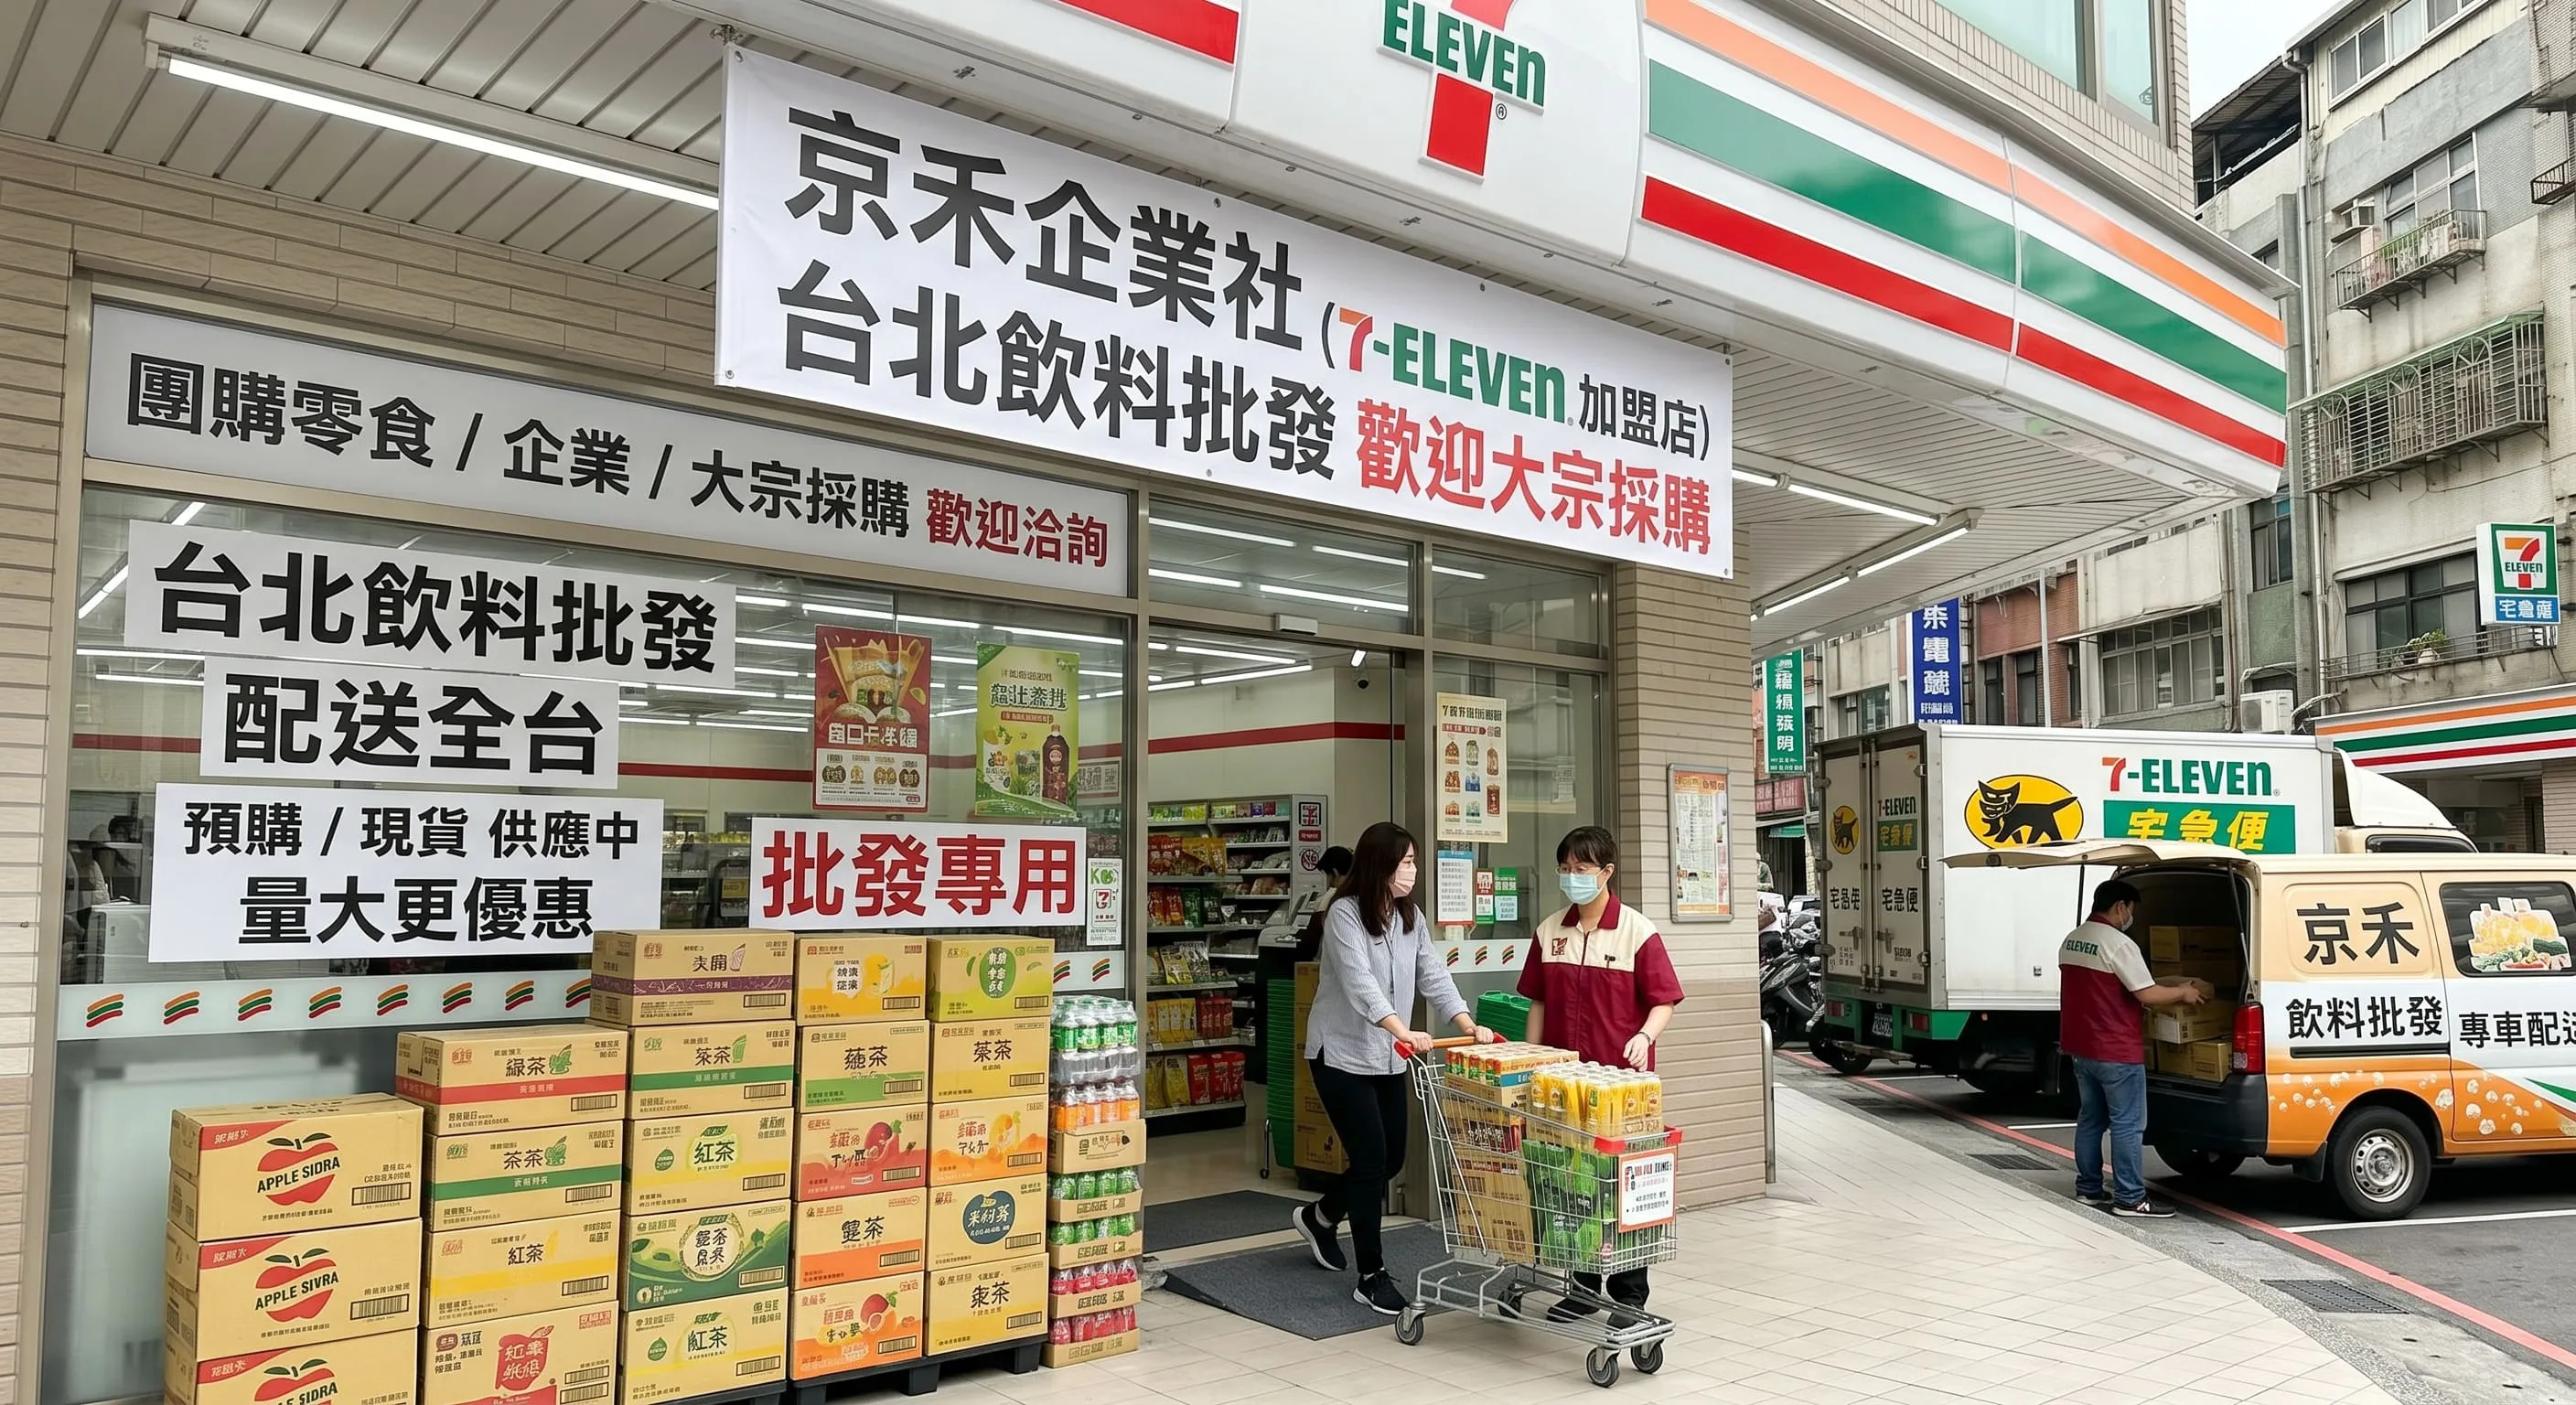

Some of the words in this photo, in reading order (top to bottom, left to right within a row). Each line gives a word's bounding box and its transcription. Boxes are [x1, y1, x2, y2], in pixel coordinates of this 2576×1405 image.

[784, 107, 1304, 351] 京禾企業社
[778, 260, 1336, 481] 台北飲料批發
[1357, 399, 1711, 554] 歡迎大宗採購
[126, 353, 435, 468] 團購零食
[503, 418, 631, 496] 企業
[691, 447, 911, 540] 大宗採購
[927, 489, 1108, 567] 歡迎洽詢
[154, 540, 718, 676] 台北飲料批發
[224, 679, 604, 776] 配送全台
[184, 802, 303, 857] 預購
[360, 806, 469, 859] 現貨
[488, 808, 639, 861] 供應中
[762, 831, 1077, 917] 批發專用
[1882, 887, 1918, 912] 宅急便
[238, 875, 595, 946] 量大更優惠
[2296, 902, 2420, 966] 京禾
[2286, 996, 2443, 1040] 飲料批發
[257, 1171, 299, 1195] APPLE
[302, 1156, 341, 1181] SIDRA
[255, 1285, 297, 1311] APPLE
[299, 1381, 338, 1405] SIDRA
